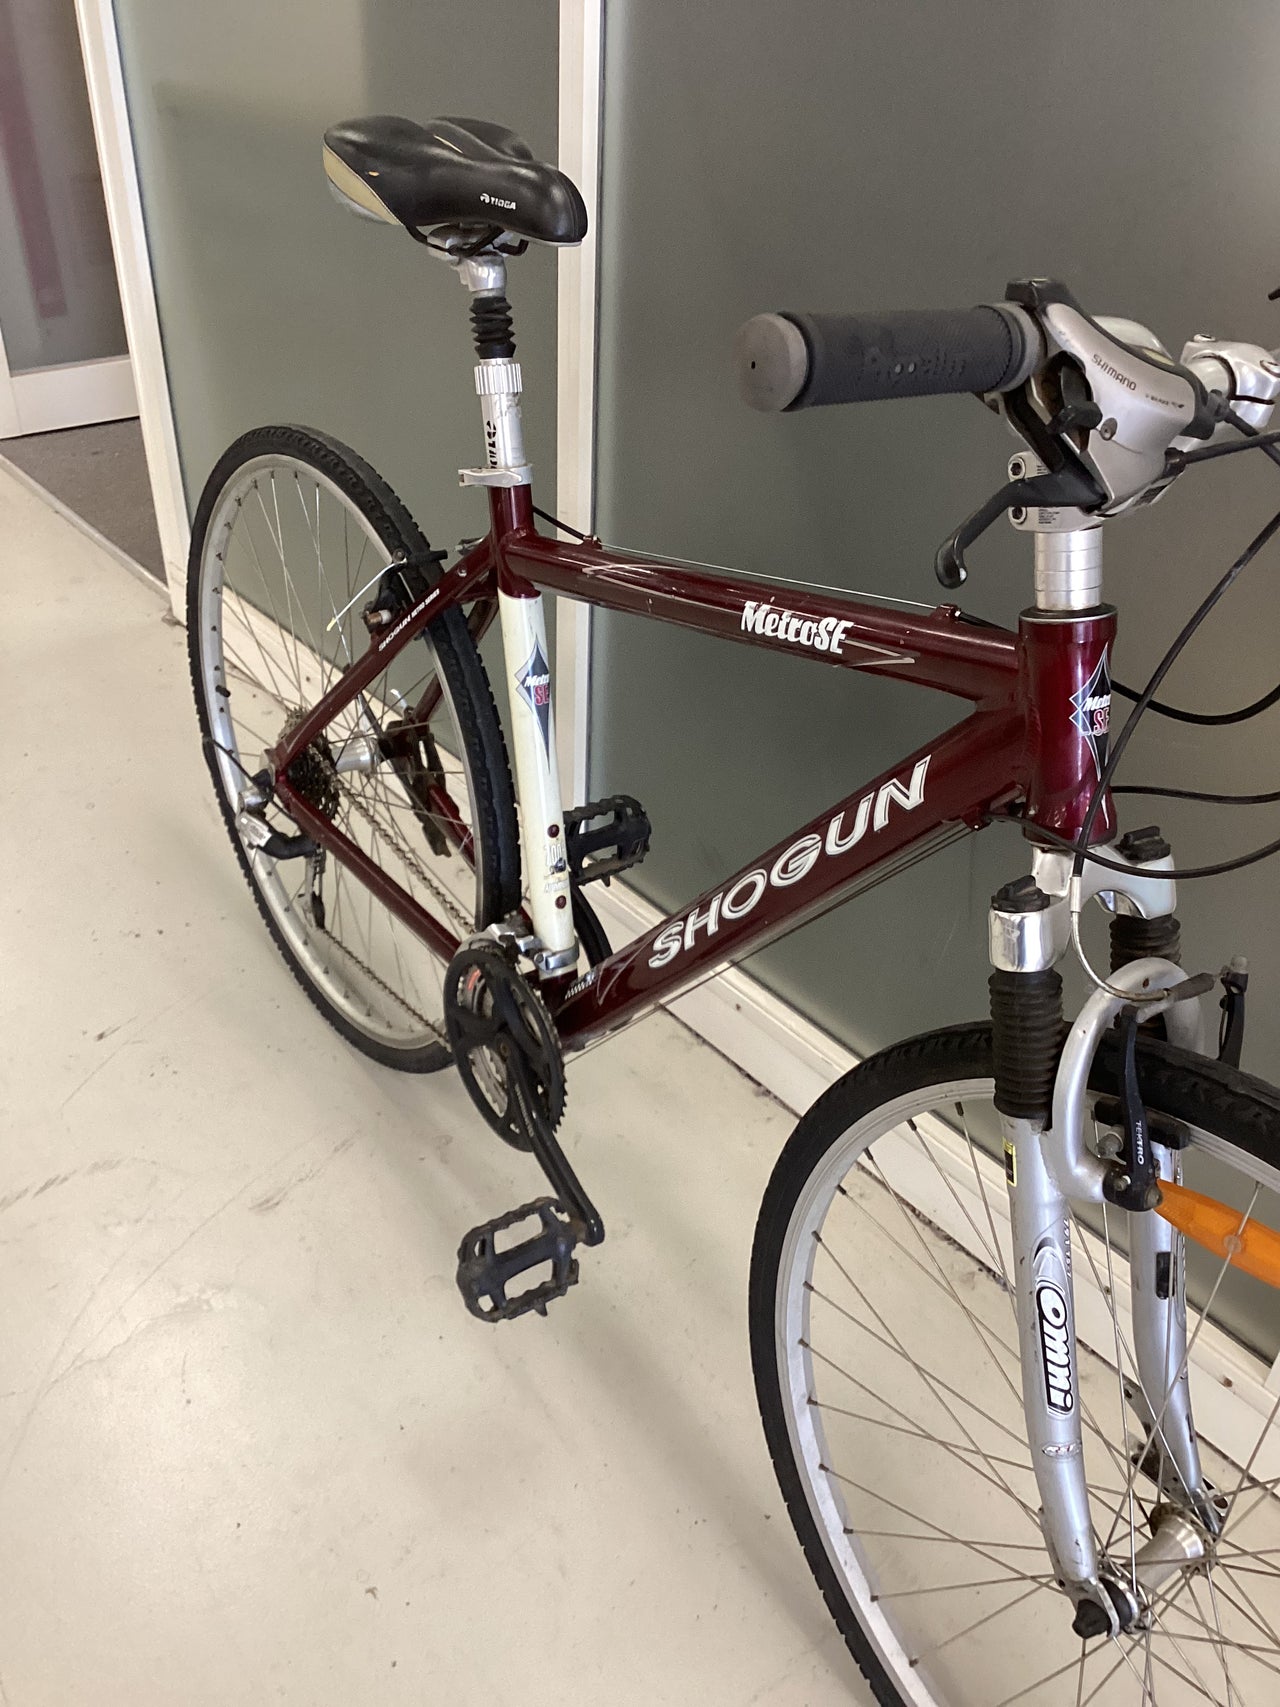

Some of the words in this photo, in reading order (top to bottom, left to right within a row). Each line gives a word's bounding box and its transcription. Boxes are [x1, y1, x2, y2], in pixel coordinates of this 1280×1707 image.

[1092, 353, 1137, 391] SHIMANO
[378, 614, 411, 651] SHOGUN
[648, 754, 932, 968] SHOGUN
[1135, 1120, 1145, 1165] TEKTRO
[1037, 1286, 1074, 1411] Omni
